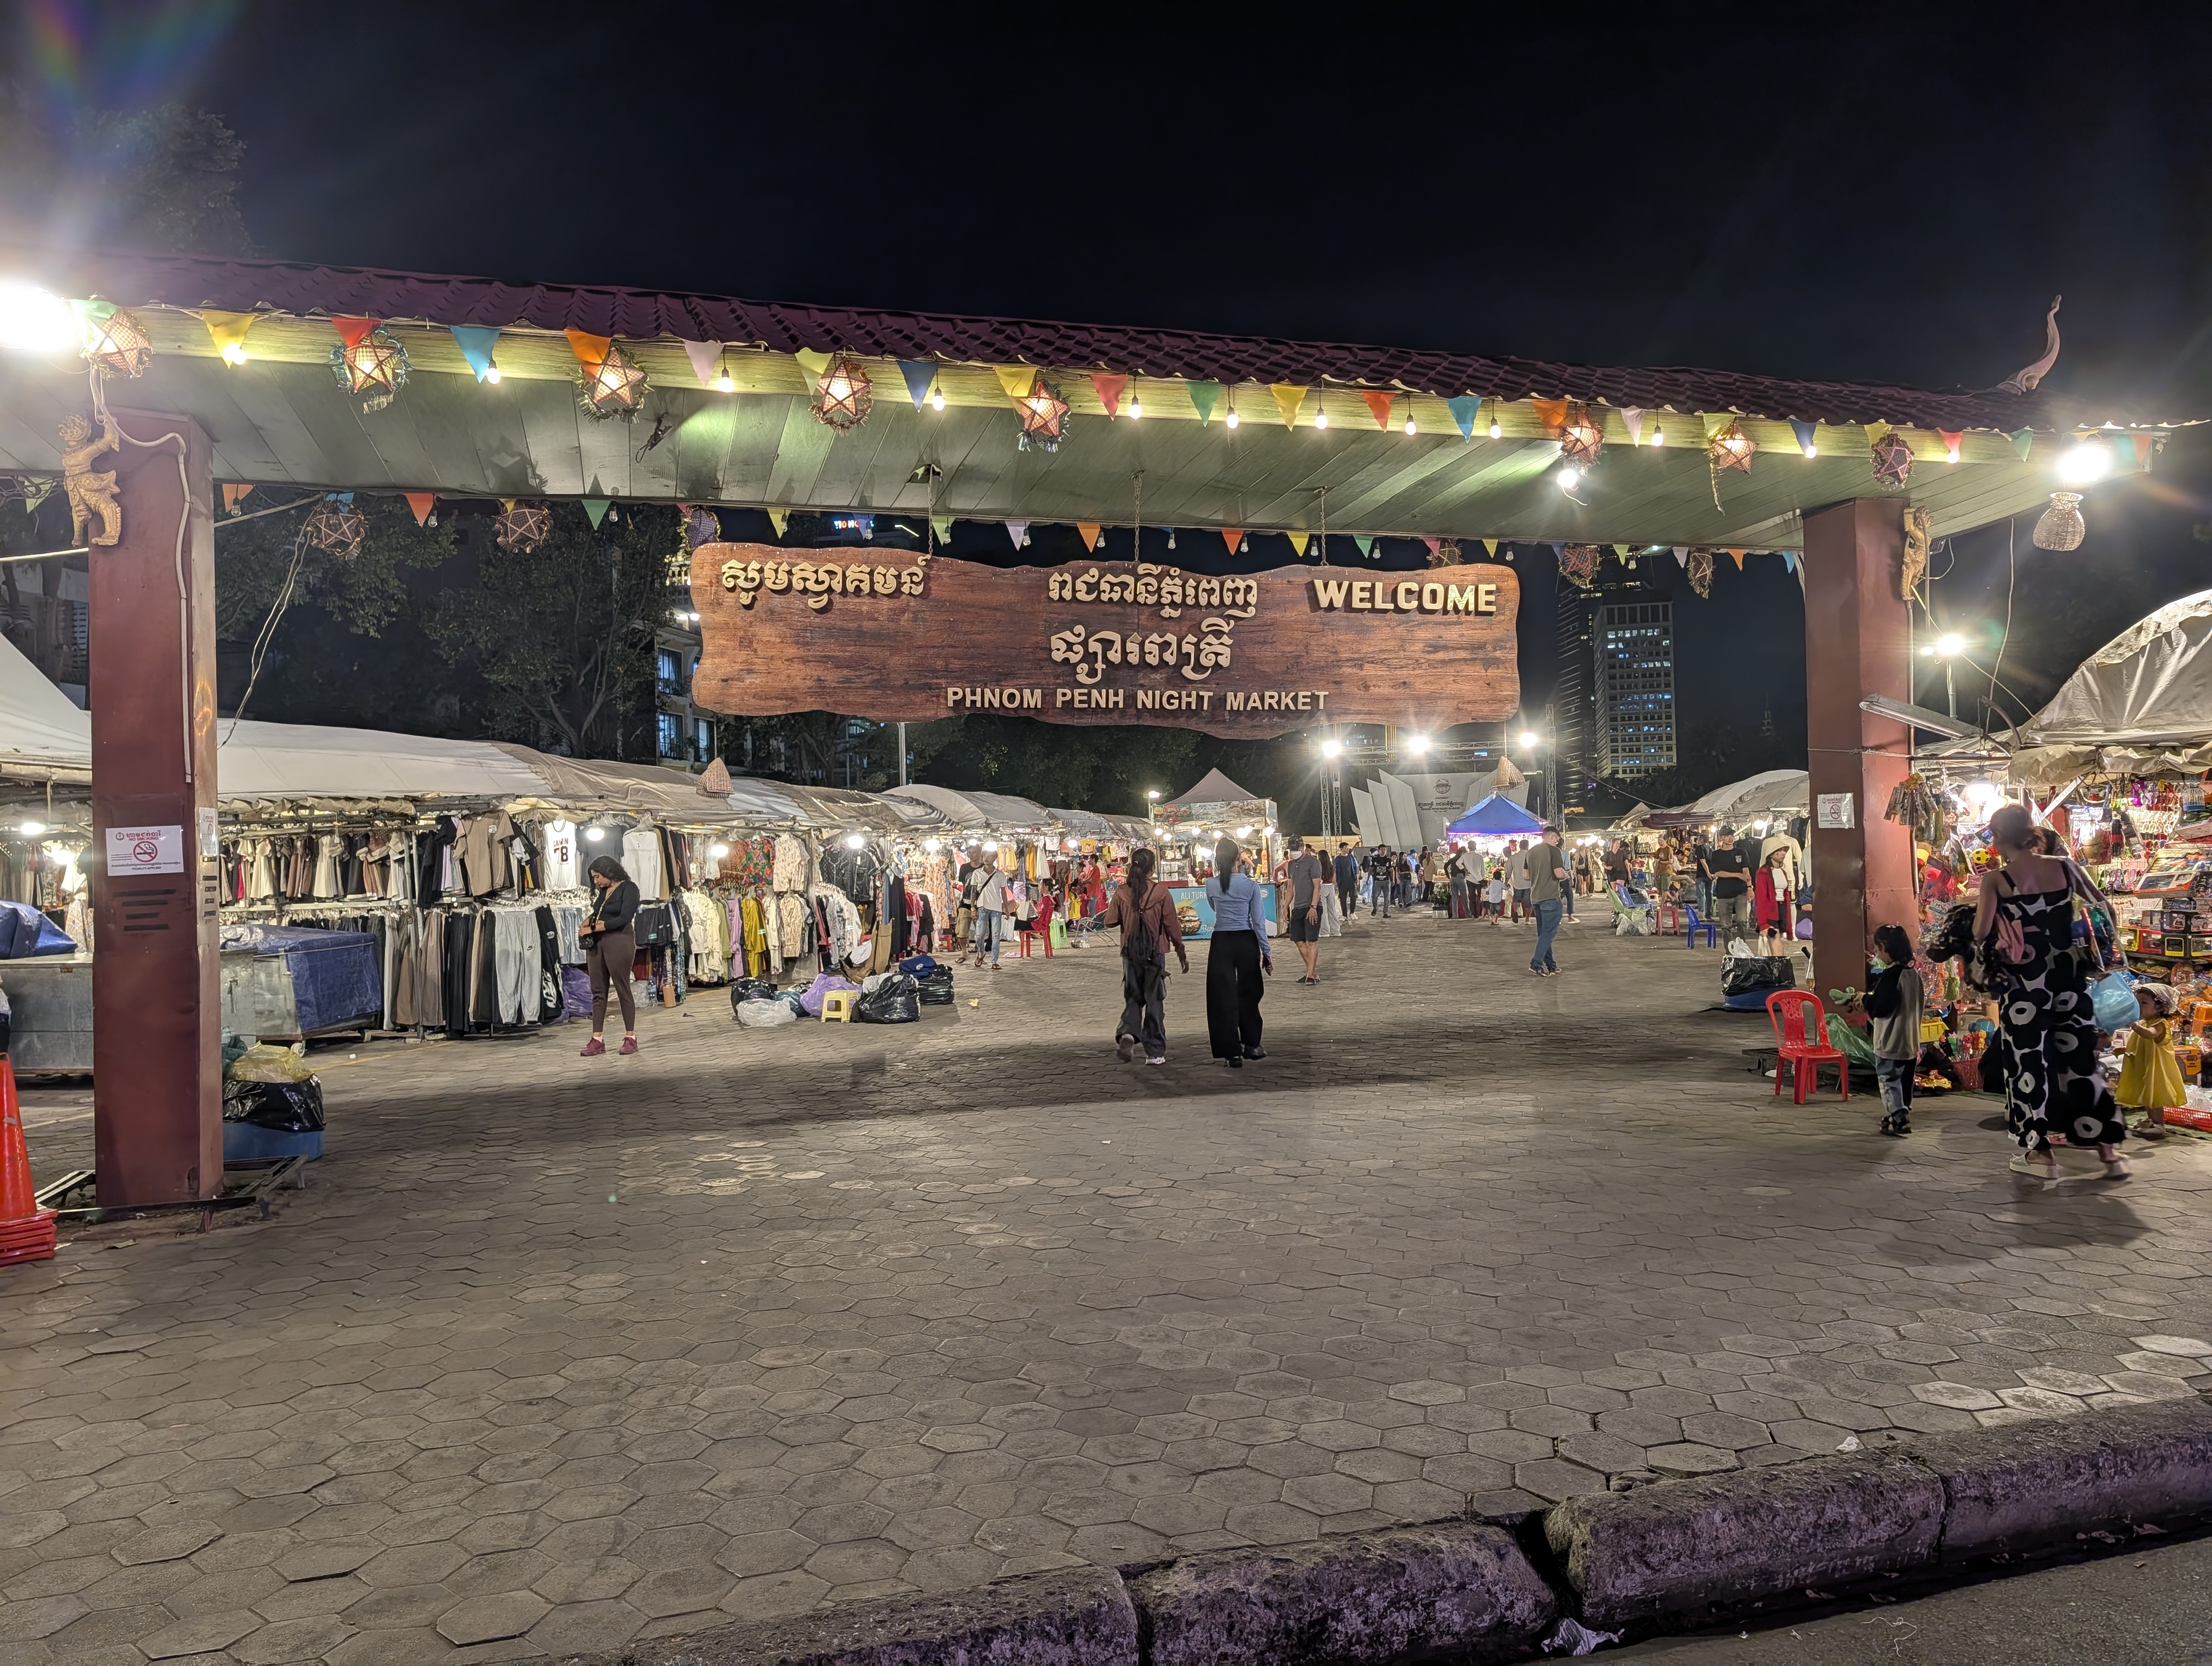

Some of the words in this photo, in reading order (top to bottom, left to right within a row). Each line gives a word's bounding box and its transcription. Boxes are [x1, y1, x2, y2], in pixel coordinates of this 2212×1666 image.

[722, 555, 931, 609] សូមស្វាគមន៍
[1049, 563, 1257, 618] រាជធានីភ្នំពេញ
[1314, 579, 1496, 611] WELCOME
[1051, 617, 1234, 684] ផ្សាររាត្រី
[948, 687, 1041, 708] PHNOM
[1056, 689, 1124, 708] PENH
[1137, 690, 1213, 710] NIGHT
[1226, 691, 1329, 710] MARKET
[1181, 892, 1191, 900] ALI
